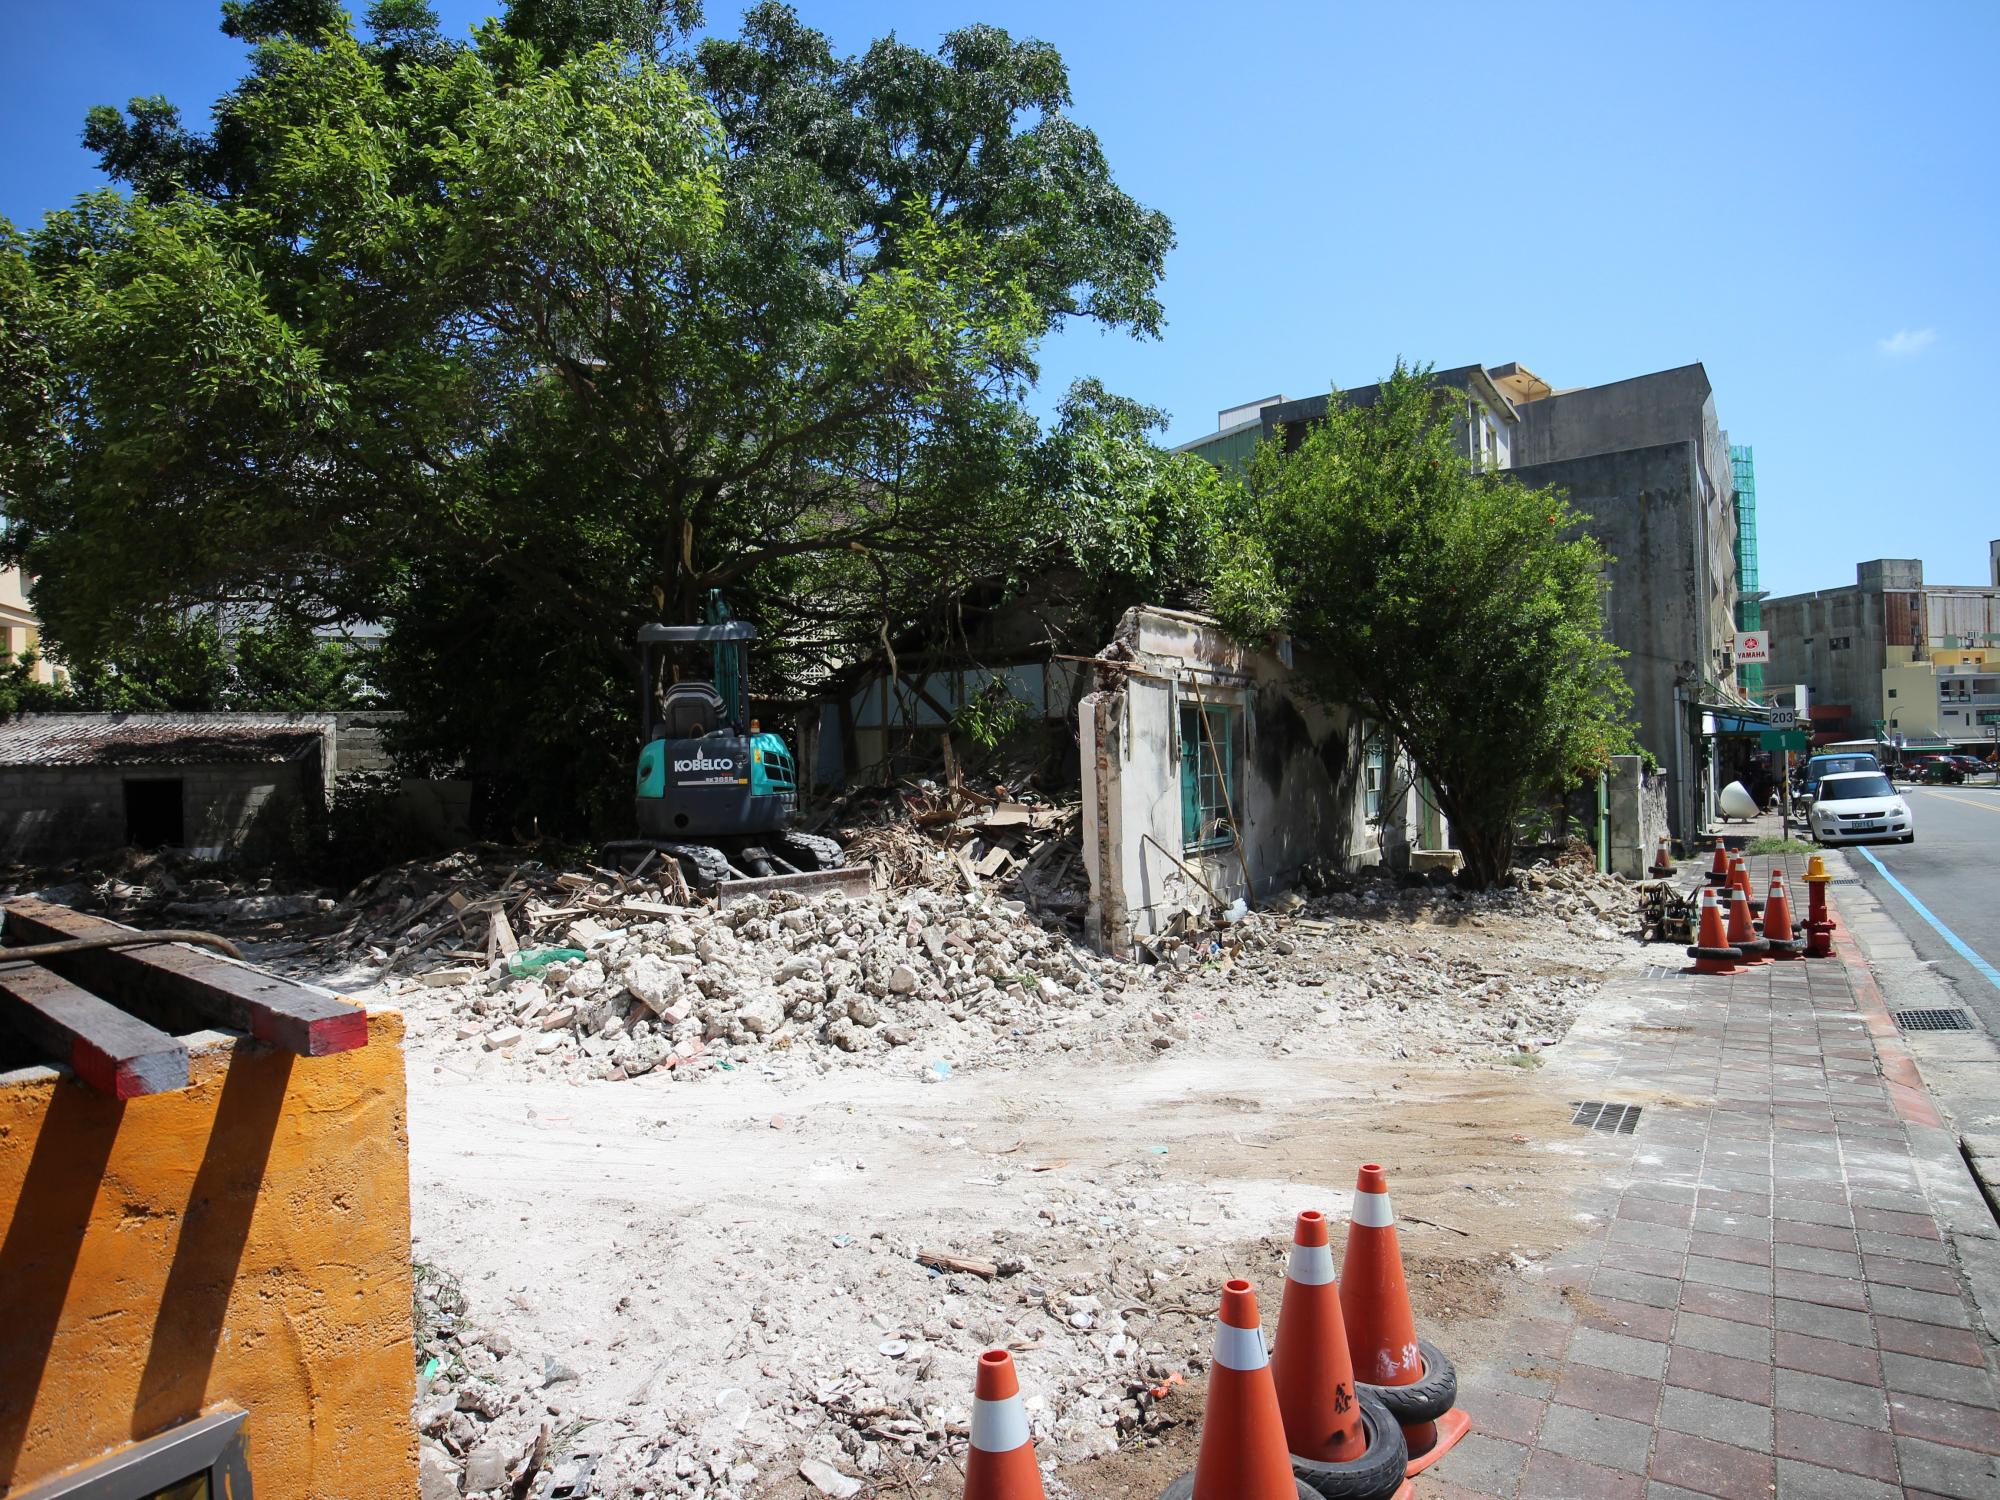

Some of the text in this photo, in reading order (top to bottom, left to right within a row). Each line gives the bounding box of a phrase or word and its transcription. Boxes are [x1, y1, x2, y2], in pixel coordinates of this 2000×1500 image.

[1738, 651, 1766, 659] YAMAHA
[1772, 712, 1793, 723] 203
[674, 758, 733, 772] KOBELCO
